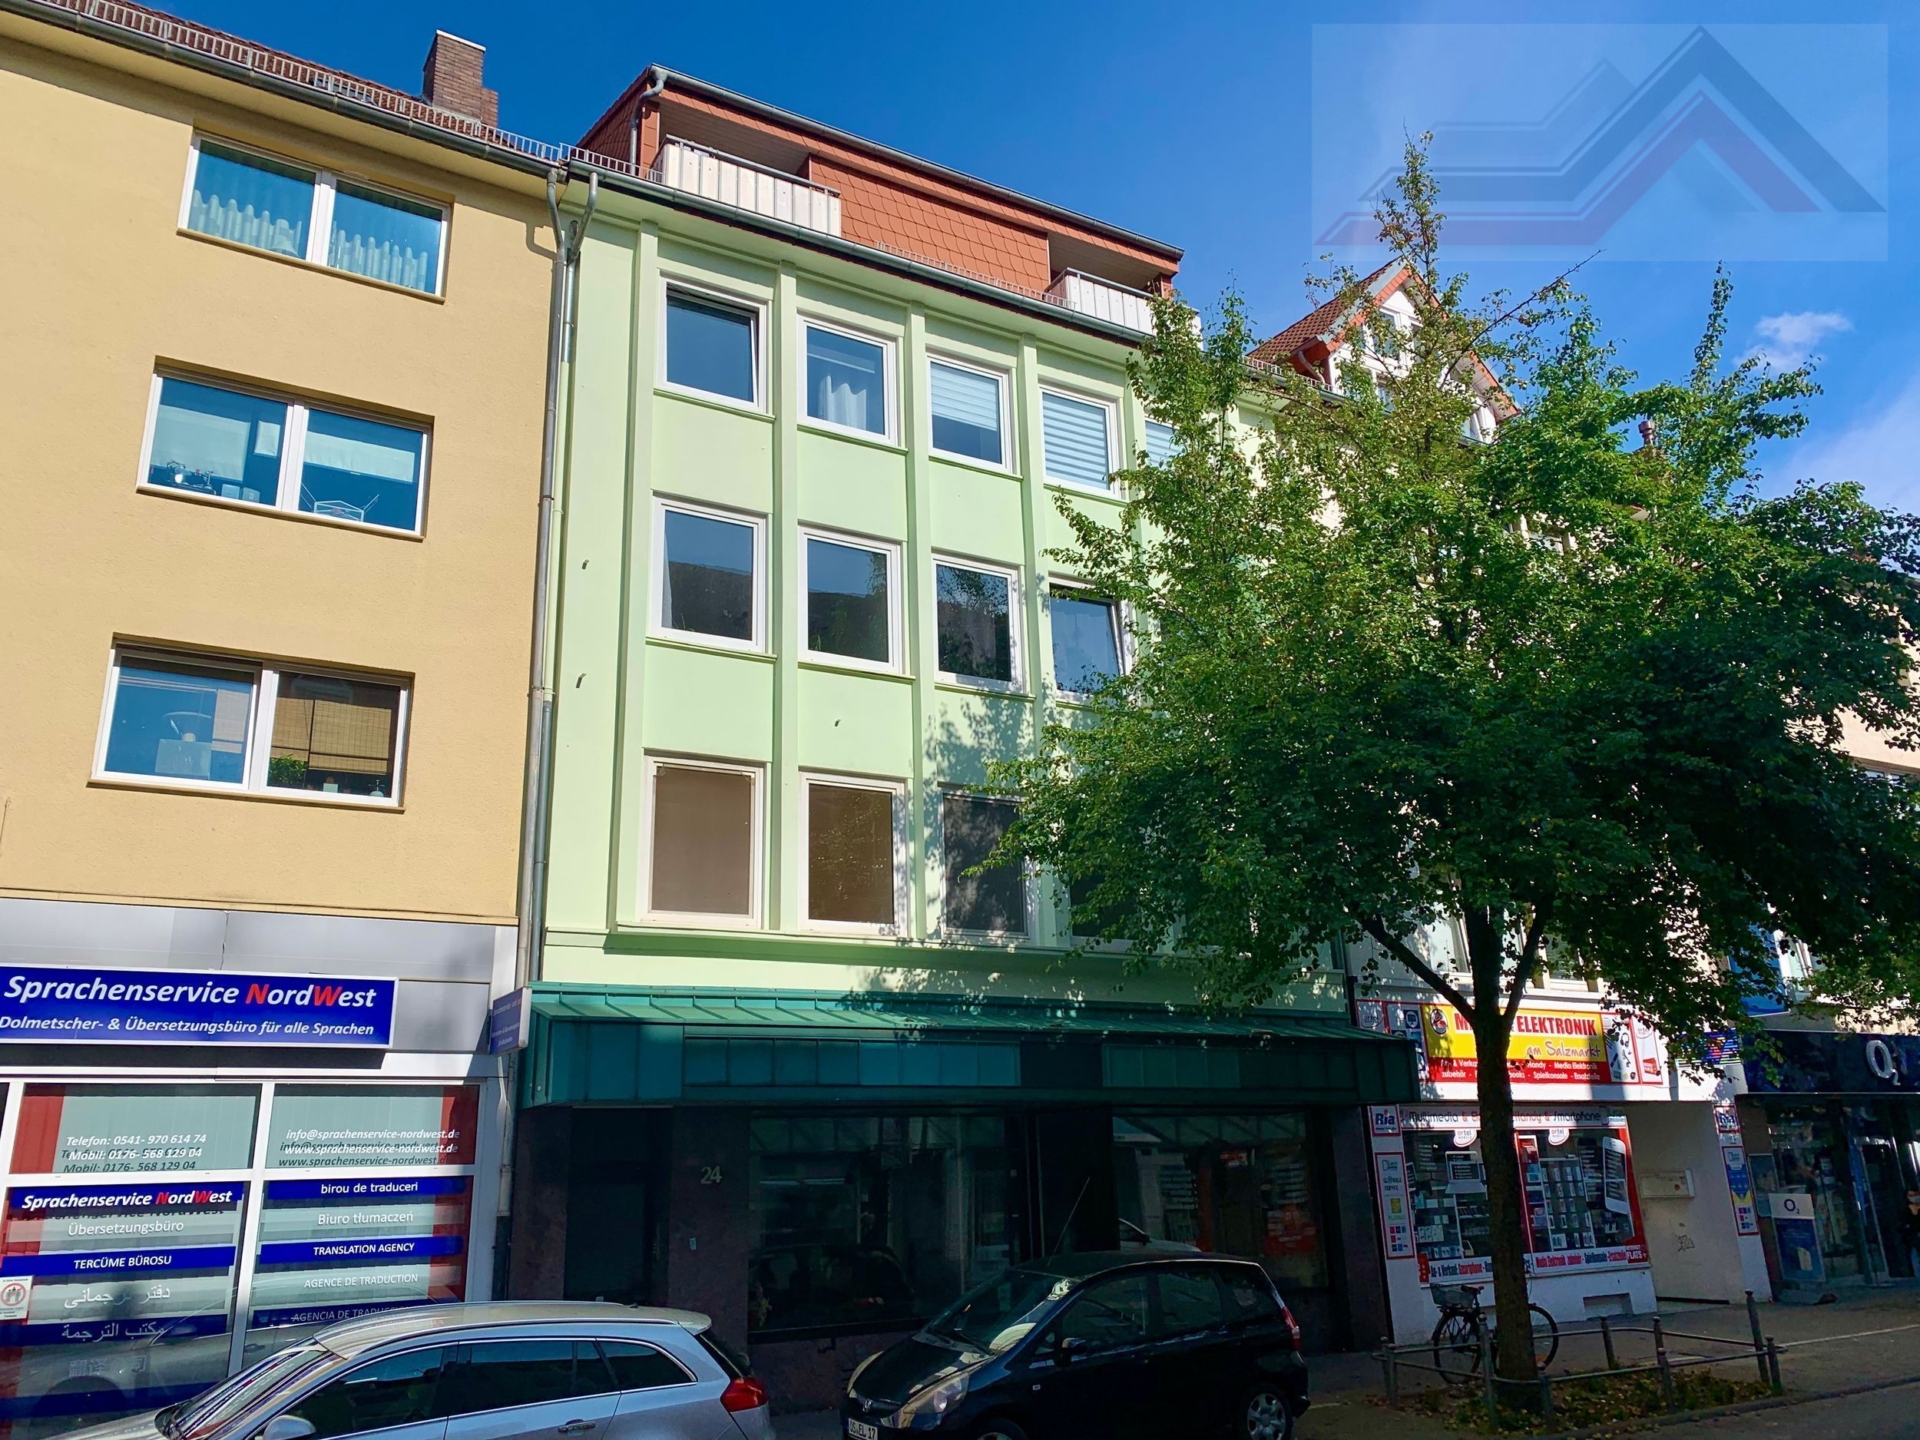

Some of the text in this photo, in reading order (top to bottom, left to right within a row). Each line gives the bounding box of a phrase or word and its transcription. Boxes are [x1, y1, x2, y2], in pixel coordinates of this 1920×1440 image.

[4, 975, 377, 1008] Sprachenservice NordWest
[0, 1016, 374, 1036] Dolmetscher- & Übersetzungsbüro für alle Sprachen
[1516, 1015, 1597, 1036] ELEKTRONIK
[1526, 1041, 1600, 1058] am Salzmarkt
[1375, 1109, 1395, 1125] Ria
[1408, 1111, 1459, 1123] Multimedia
[66, 1134, 207, 1147] Telefon: 0541- 970 614 74
[286, 1129, 460, 1141] info@sprachenservice-nordwest.de
[68, 1148, 203, 1161] Mobil: 0176- 568 129 04
[284, 1144, 458, 1156] www.sprachenservice-nordwest.de
[700, 1165, 722, 1184] 24
[321, 1182, 418, 1194] birou de traduceri
[22, 1190, 233, 1211] Sprachenservice NordWest
[318, 1210, 413, 1226] Biuro tłumaczeń
[68, 1219, 184, 1236] Übersetzungsbüro
[313, 1242, 415, 1256] TRANSLATION AGENCY
[73, 1255, 172, 1270] TERCÜME BÜROSU
[304, 1274, 418, 1289] AGENCE DE TRADUCTION
[292, 1311, 335, 1323] AGENCIA
[337, 1310, 350, 1320] DE
